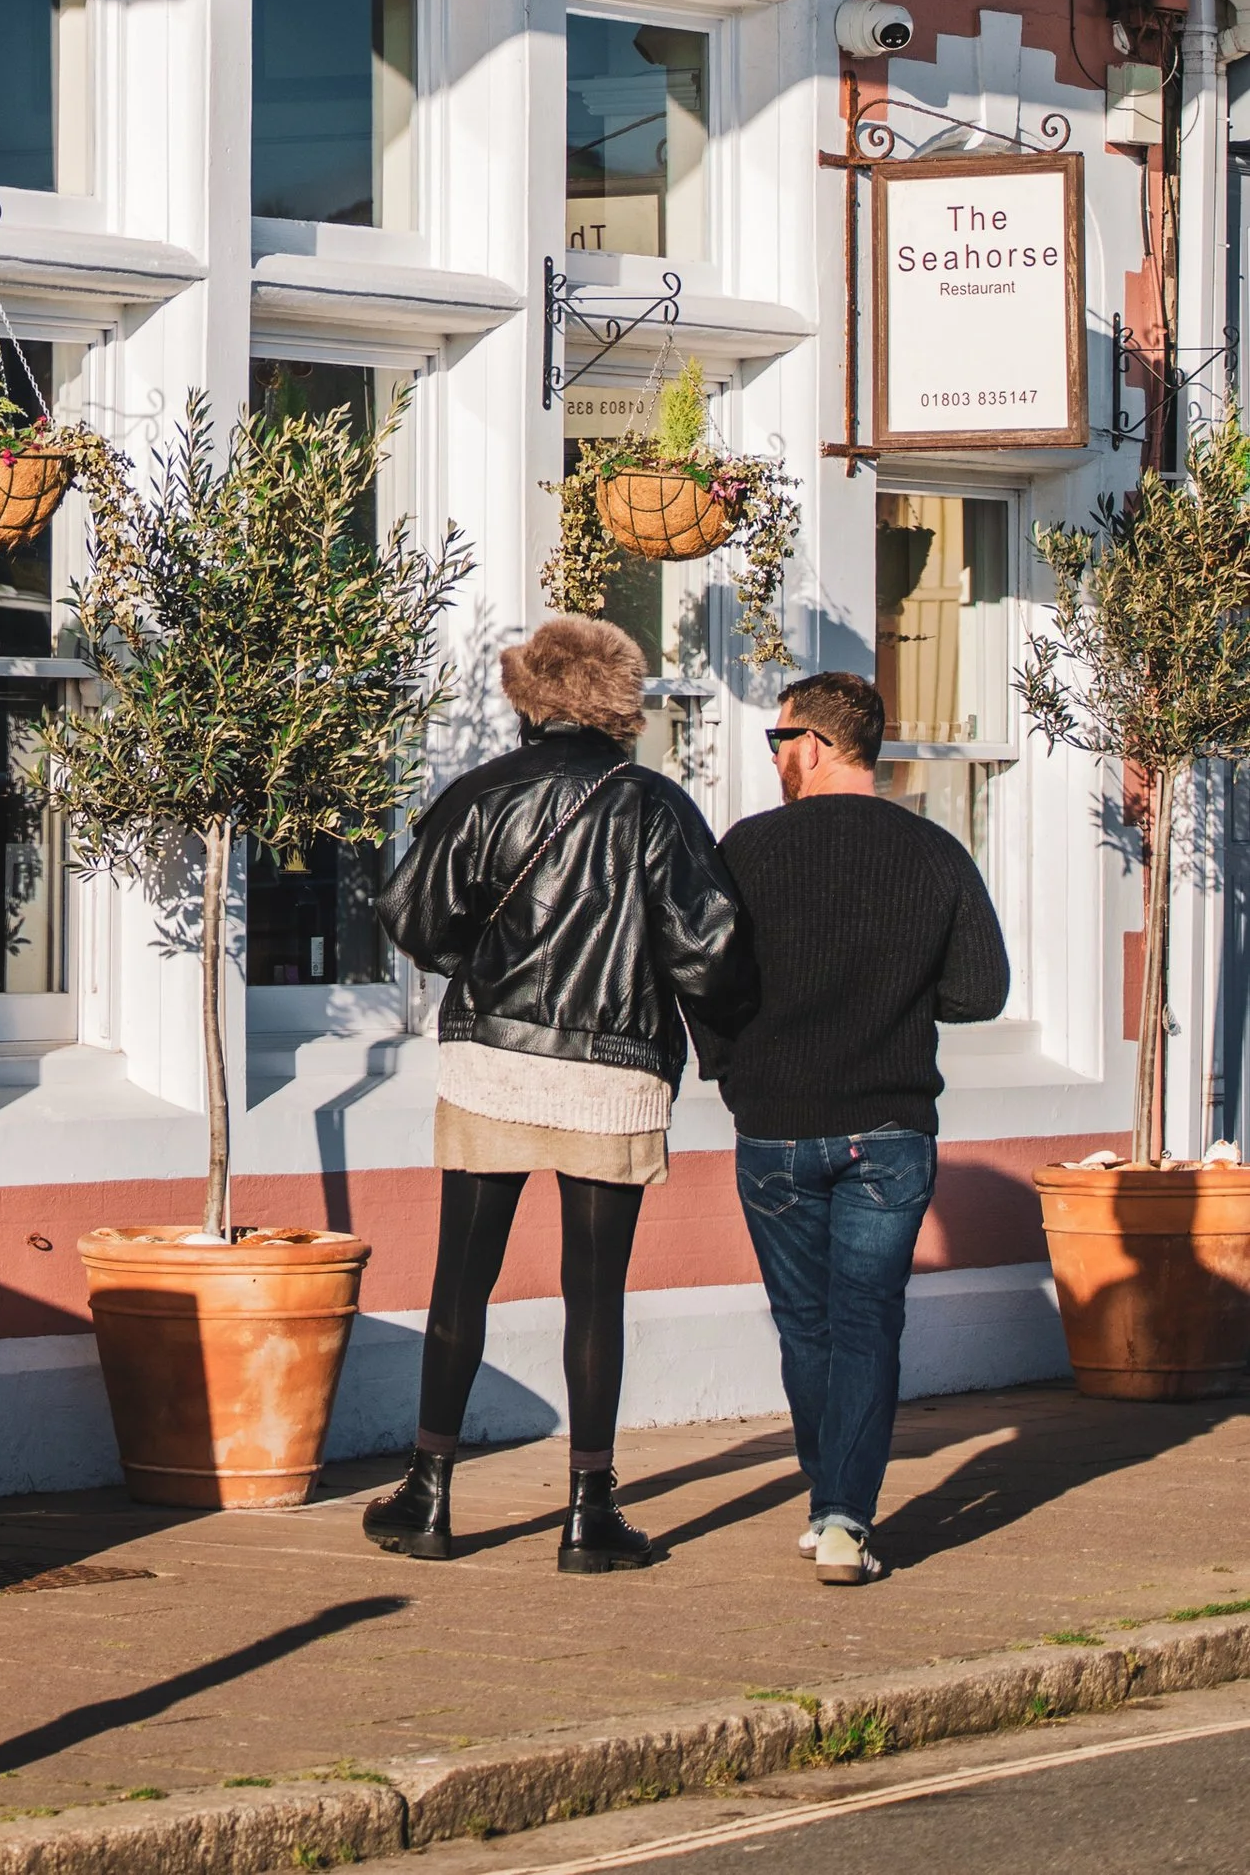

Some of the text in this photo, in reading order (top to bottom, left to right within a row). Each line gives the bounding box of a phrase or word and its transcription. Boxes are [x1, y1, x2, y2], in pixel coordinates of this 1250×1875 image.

[946, 205, 1008, 232] The
[897, 243, 1059, 273] Seahorse
[939, 280, 1016, 297] Restaurant
[920, 389, 1039, 407] 01803 835147
